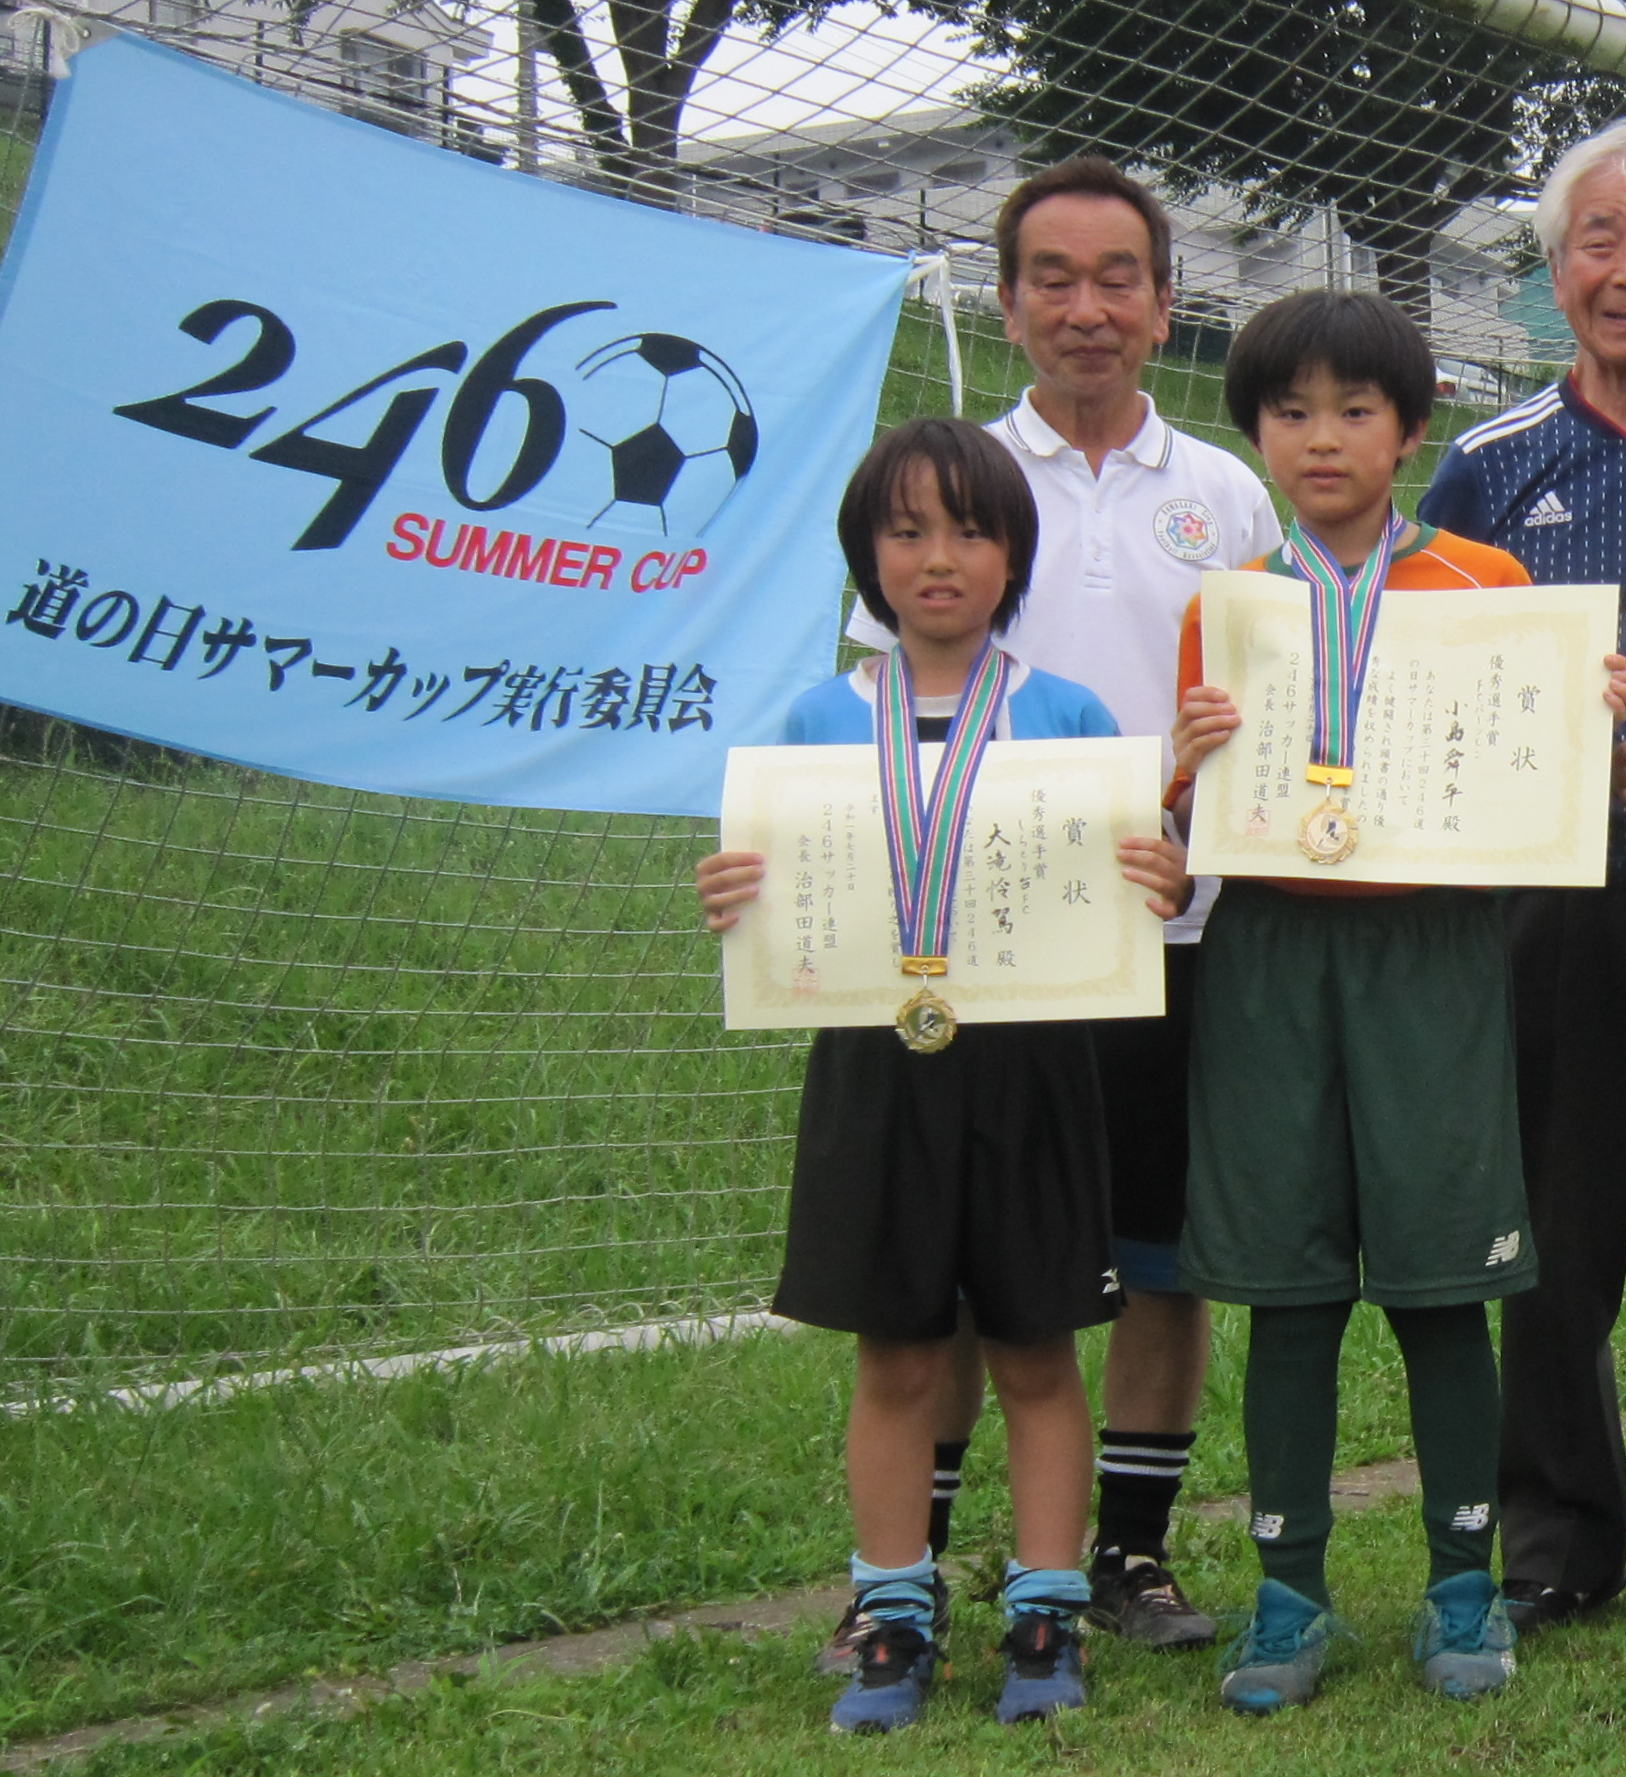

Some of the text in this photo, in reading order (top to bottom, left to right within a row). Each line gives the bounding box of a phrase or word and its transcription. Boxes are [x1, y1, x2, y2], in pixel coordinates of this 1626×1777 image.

[113, 299, 618, 551] 246
[386, 512, 708, 594] SUMMER CUP
[1524, 511, 1572, 527] adidas
[5, 557, 718, 732] 道の日サマーカップ実行委員会
[1486, 654, 1505, 747] 優秀選手賞
